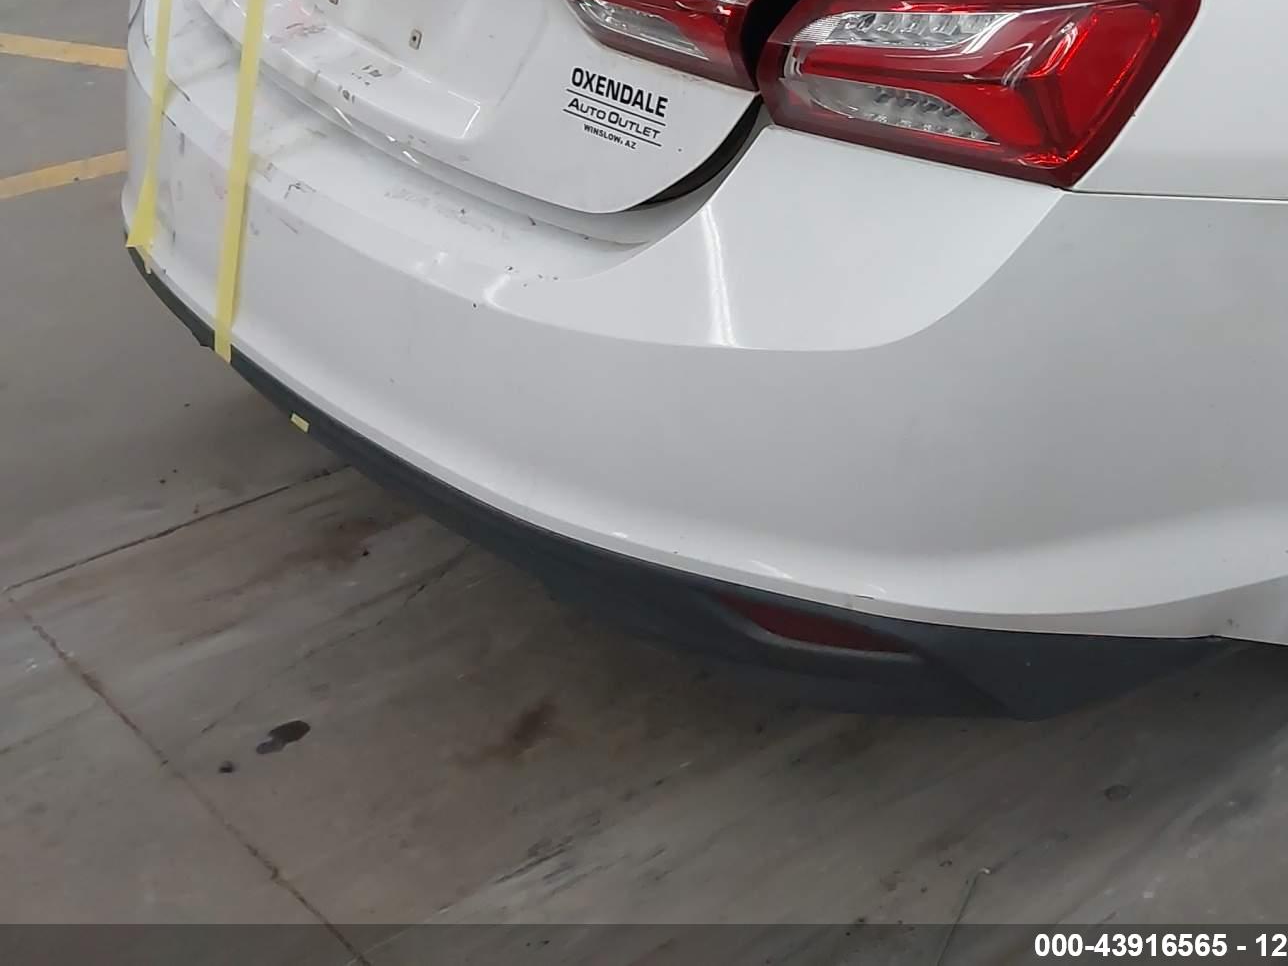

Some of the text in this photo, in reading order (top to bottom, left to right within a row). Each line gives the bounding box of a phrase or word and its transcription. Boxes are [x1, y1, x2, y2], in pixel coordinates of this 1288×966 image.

[571, 67, 668, 118] OXENDALE
[583, 123, 637, 150] WINSLOW, AZ
